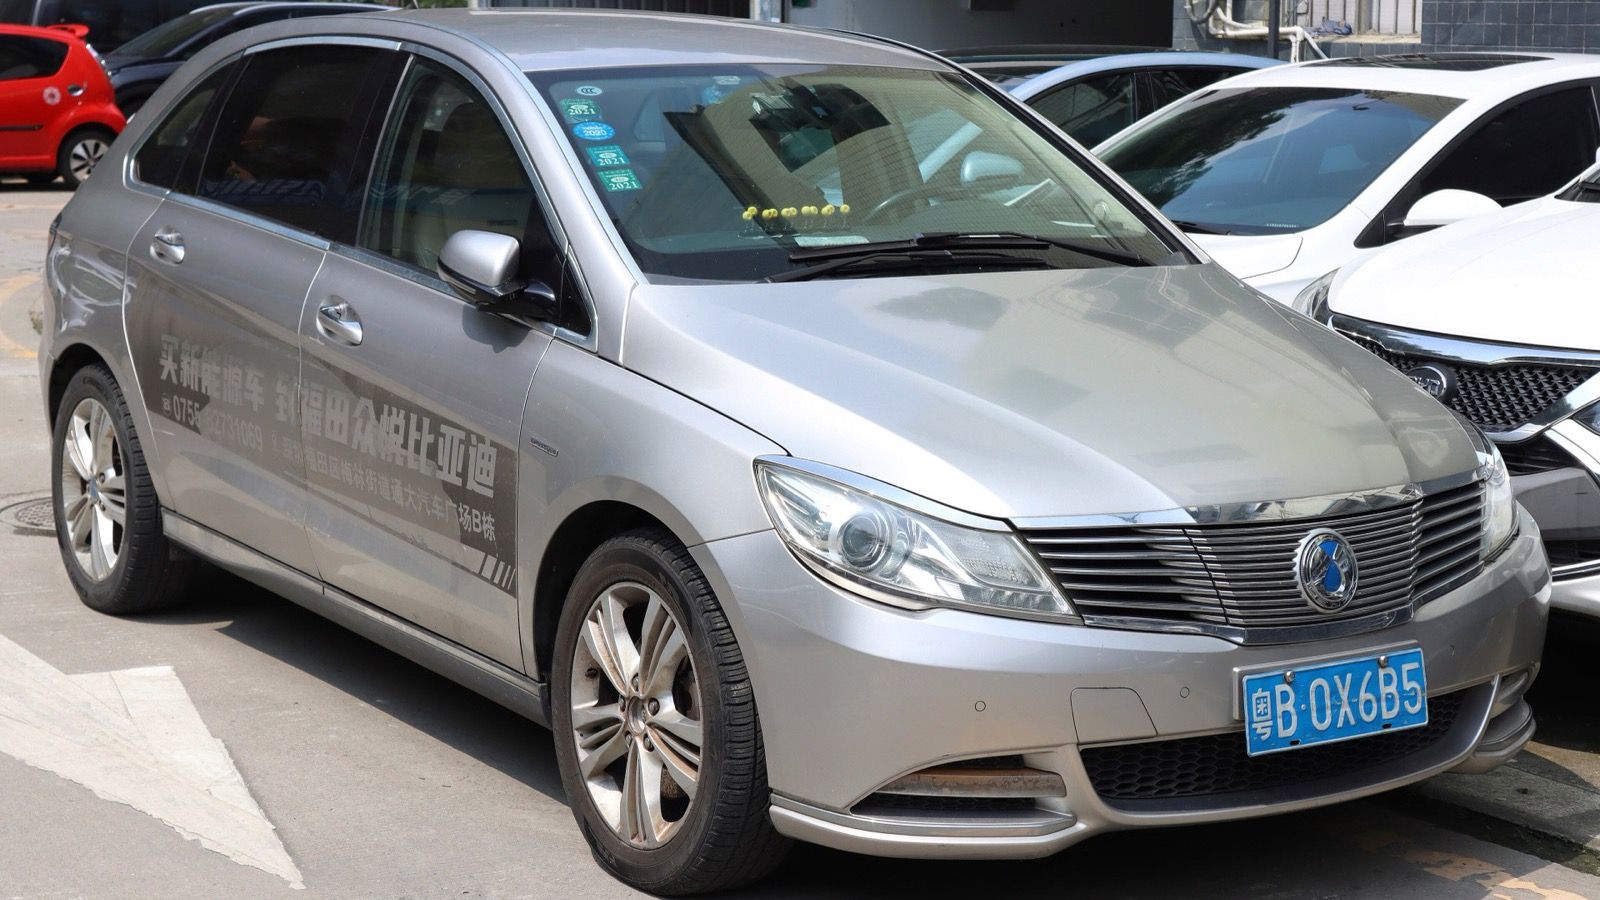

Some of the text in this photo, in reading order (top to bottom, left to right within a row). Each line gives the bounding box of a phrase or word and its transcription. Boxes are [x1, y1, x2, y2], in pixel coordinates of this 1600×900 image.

[568, 108, 596, 116] 2021
[597, 157, 626, 166] 2021
[608, 181, 639, 190] 2021
